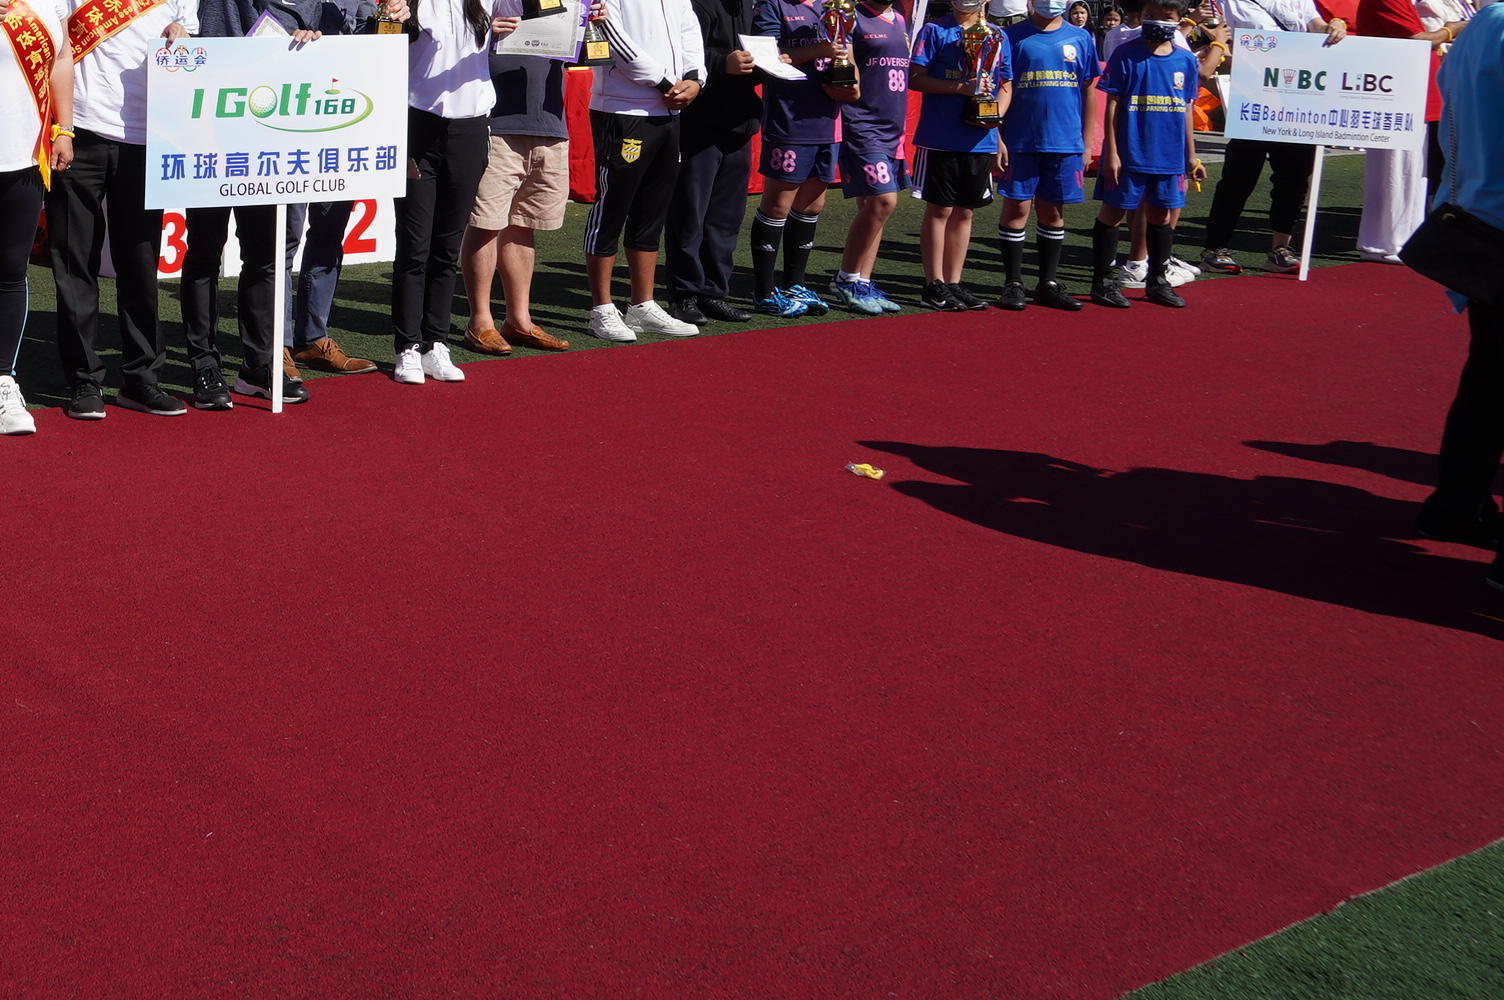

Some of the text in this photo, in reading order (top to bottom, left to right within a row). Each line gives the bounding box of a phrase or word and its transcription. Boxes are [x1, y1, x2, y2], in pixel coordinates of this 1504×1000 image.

[25, 16, 52, 59] American
[865, 57, 878, 67] JF
[888, 68, 906, 93] 88
[315, 98, 356, 115] 168
[1262, 126, 1277, 136] New
[1278, 127, 1291, 137] York
[1299, 128, 1314, 140] Long
[1315, 129, 1334, 139] Island
[1370, 133, 1391, 143] Center
[161, 145, 398, 181] 环球高尔夫俱乐部
[769, 148, 797, 173] 88
[863, 161, 891, 185] 88
[219, 178, 346, 197] GLOBAL GOLF CLUB
[343, 199, 378, 255] 2
[157, 212, 188, 273] 3
